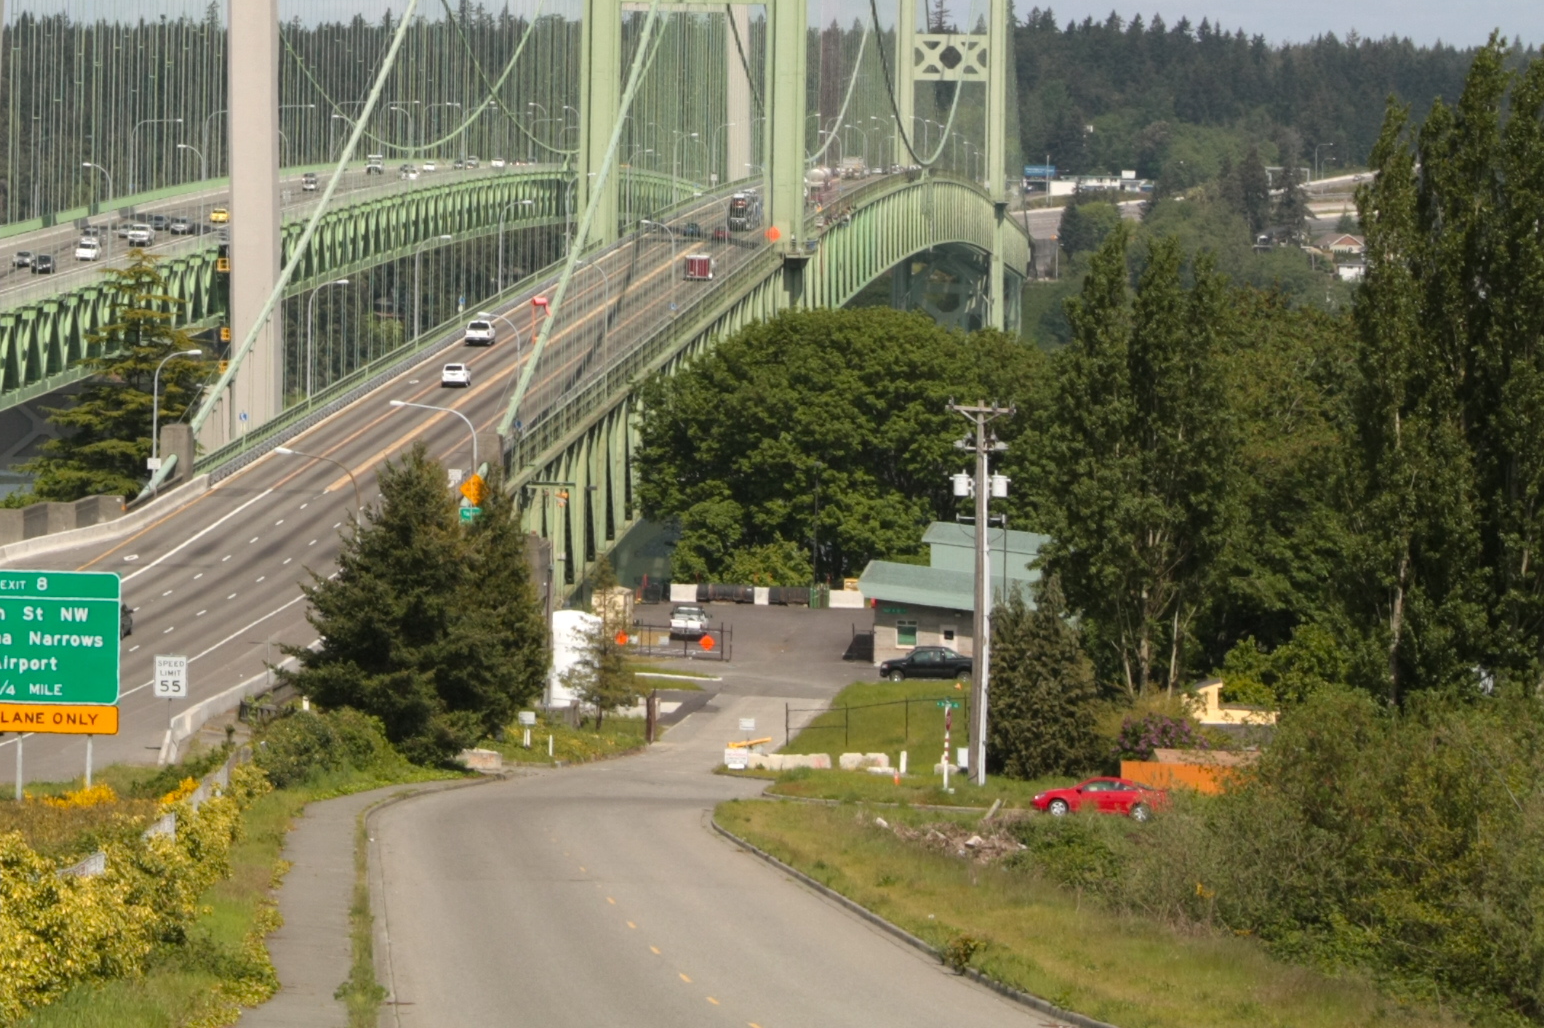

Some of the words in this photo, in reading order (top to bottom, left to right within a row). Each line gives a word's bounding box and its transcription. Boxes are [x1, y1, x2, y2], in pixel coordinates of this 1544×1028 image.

[0, 579, 26, 590] EXIT
[36, 576, 48, 591] 8
[22, 605, 44, 622] St
[60, 606, 89, 623] NW
[29, 630, 104, 648] Narrows
[157, 660, 185, 668] SPEED
[159, 669, 181, 677] LIMIT
[29, 682, 63, 696] MILE
[160, 680, 181, 693] 55
[0, 711, 45, 724] LANE
[52, 712, 99, 726] ONLY
